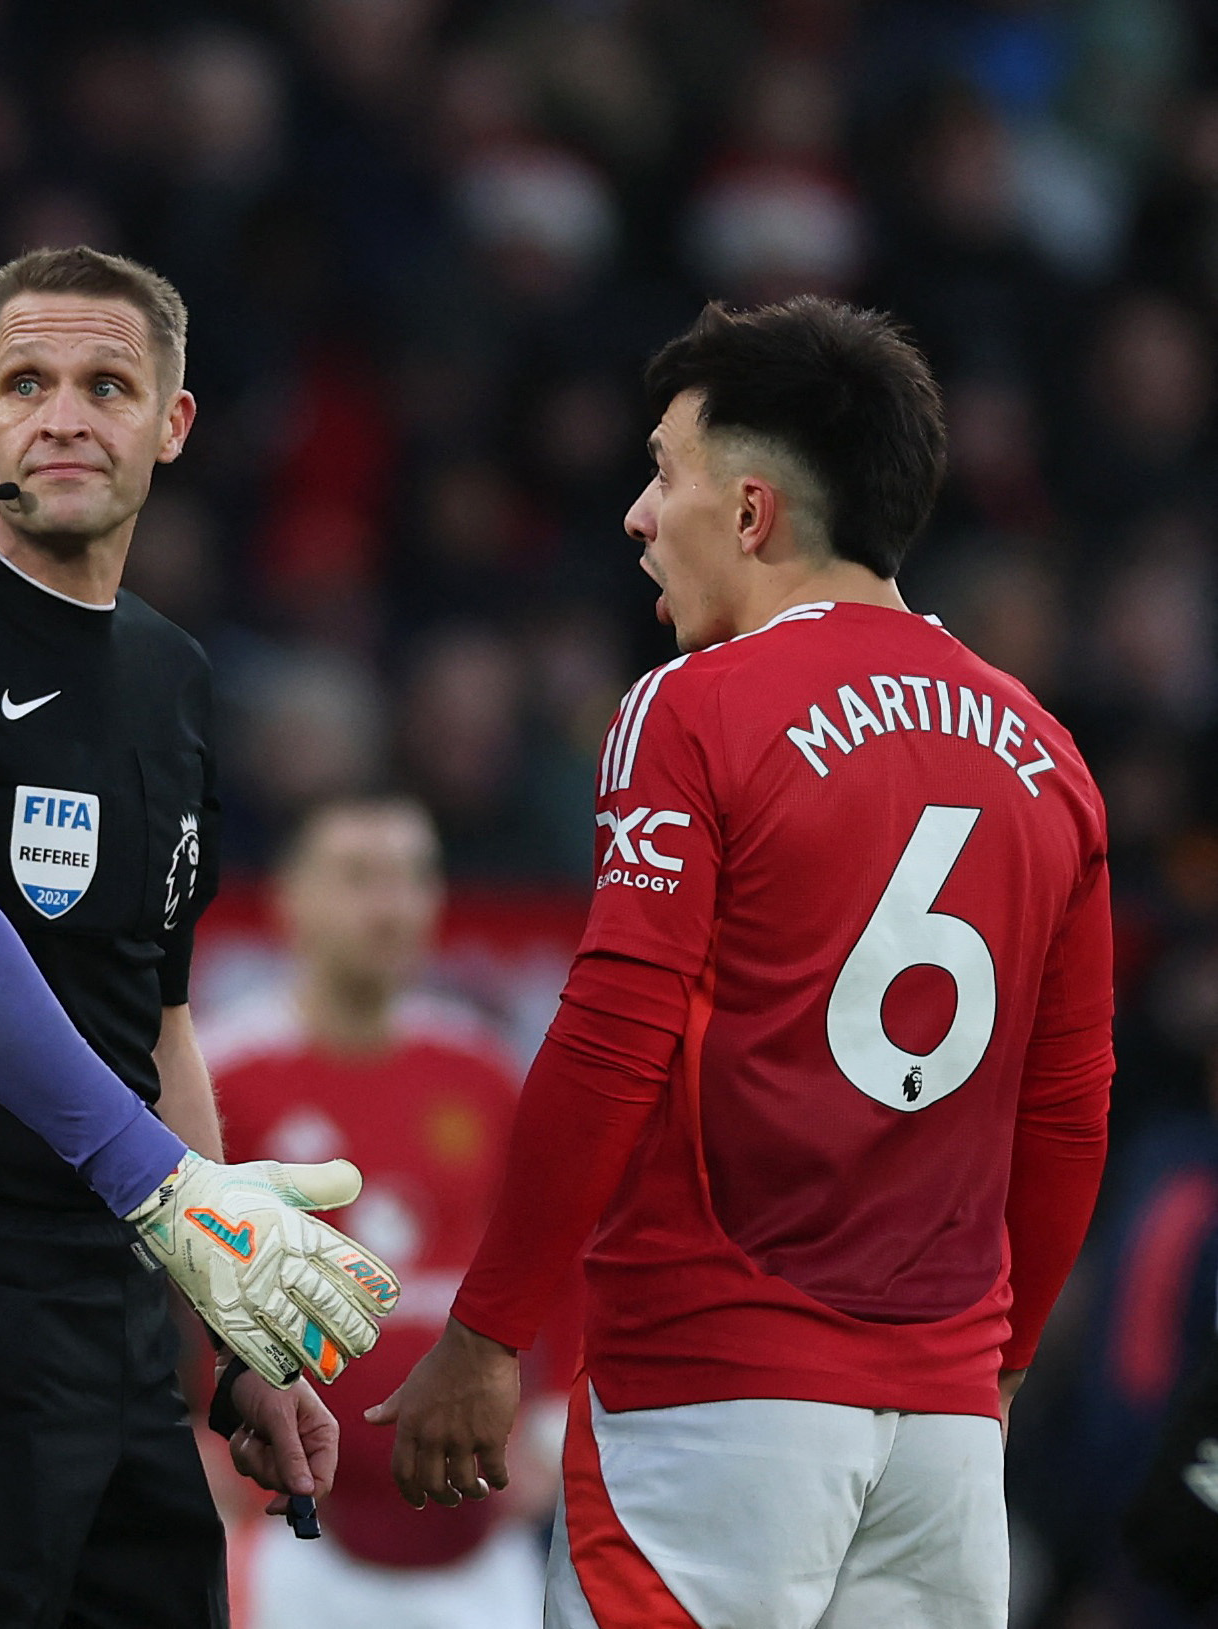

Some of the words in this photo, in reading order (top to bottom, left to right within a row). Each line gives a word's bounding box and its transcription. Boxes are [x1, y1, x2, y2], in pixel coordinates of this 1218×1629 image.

[786, 674, 1057, 798] MARTINEZ
[23, 795, 92, 832] FIFA
[19, 845, 90, 868] REFEREE
[36, 889, 69, 906] 2024
[825, 803, 998, 1114] 6
